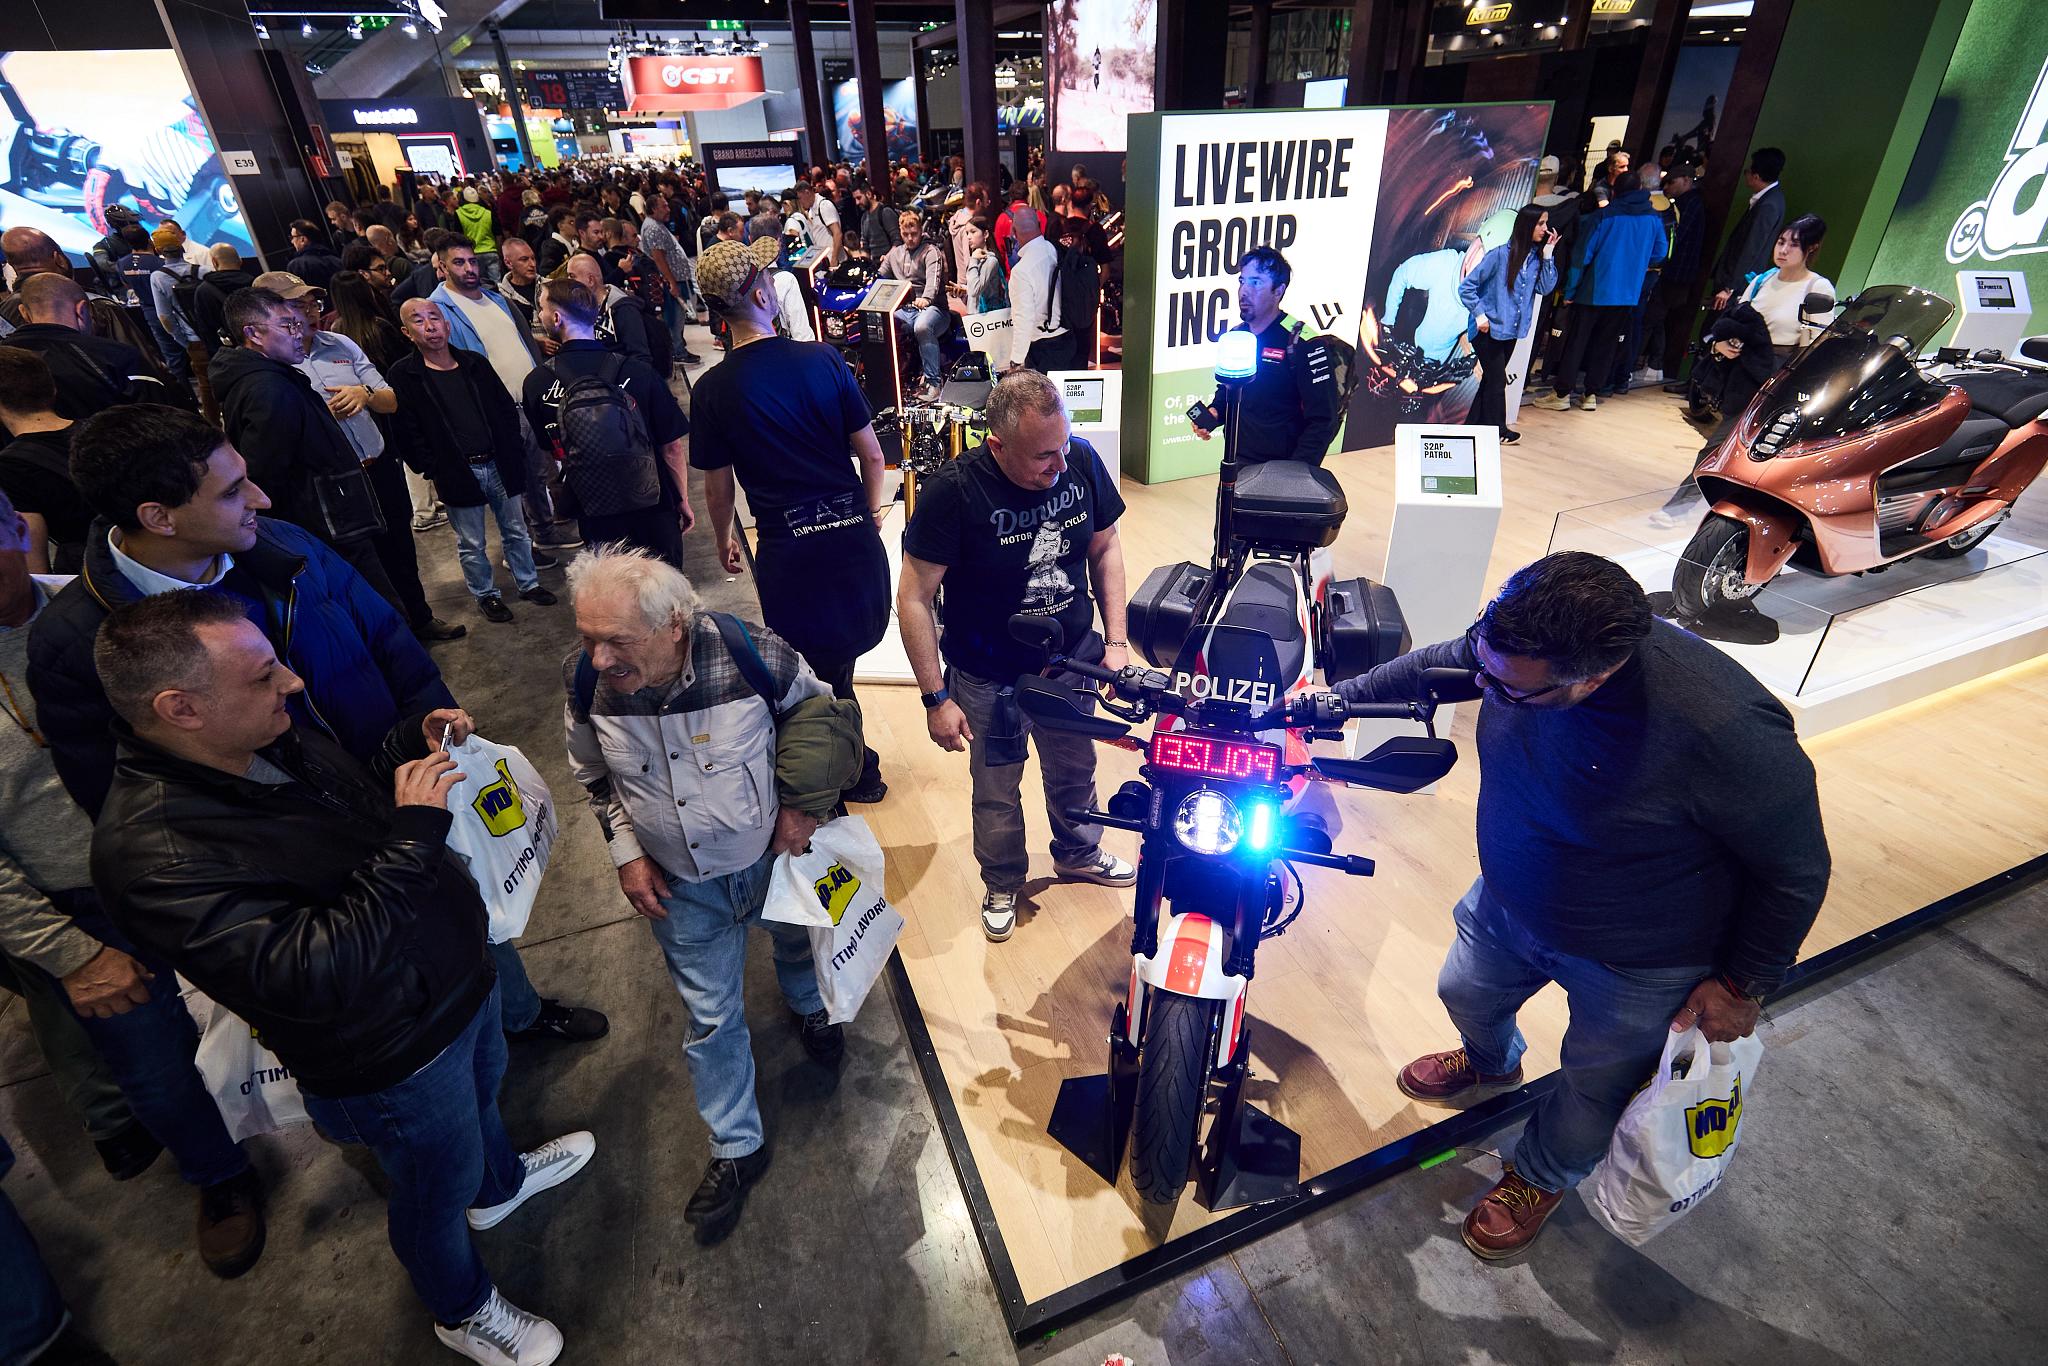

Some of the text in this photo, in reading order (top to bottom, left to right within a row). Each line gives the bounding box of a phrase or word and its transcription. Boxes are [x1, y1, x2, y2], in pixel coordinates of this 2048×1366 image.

[681, 67, 734, 84] CST
[541, 82, 567, 103] 18
[235, 159, 254, 168] E39
[1174, 138, 1354, 207] LIVEWIRE
[1163, 413, 1185, 425] the
[1424, 442, 1444, 450] S2AP
[1424, 451, 1452, 459] PATROL
[989, 482, 1084, 536] Denver
[1000, 511, 1088, 546] MOTOR CYCLES
[1174, 671, 1276, 706] POLIZEI
[503, 846, 535, 895] OTTIMO
[831, 896, 887, 971] TTIMO LAVORO
[240, 1066, 294, 1096] OTTIM
